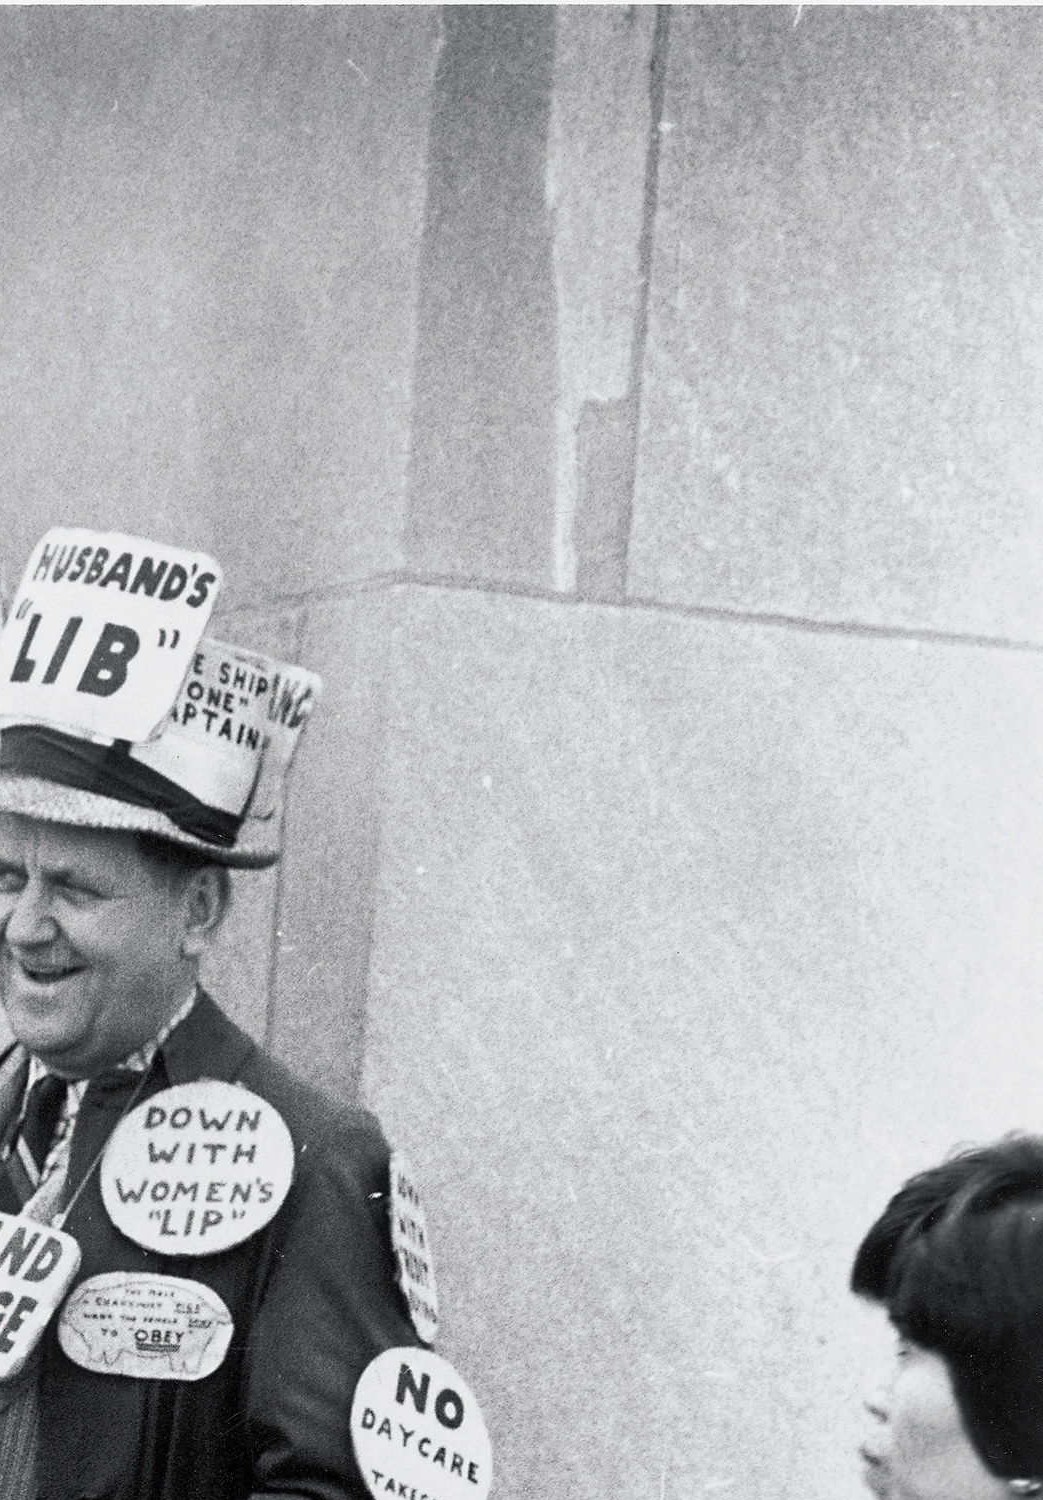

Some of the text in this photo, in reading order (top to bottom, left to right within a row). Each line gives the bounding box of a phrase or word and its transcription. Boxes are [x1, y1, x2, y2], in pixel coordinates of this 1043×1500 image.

[33, 543, 216, 608] HUSBAND'S
[10, 598, 180, 697] "LIB"
[144, 1106, 261, 1132] DOWN
[148, 1142, 257, 1164] WITH
[115, 1176, 274, 1204] WOMEN'S
[148, 1209, 246, 1237] "LIP"
[396, 1363, 464, 1430] NO
[361, 1407, 479, 1485] DAYCARE
